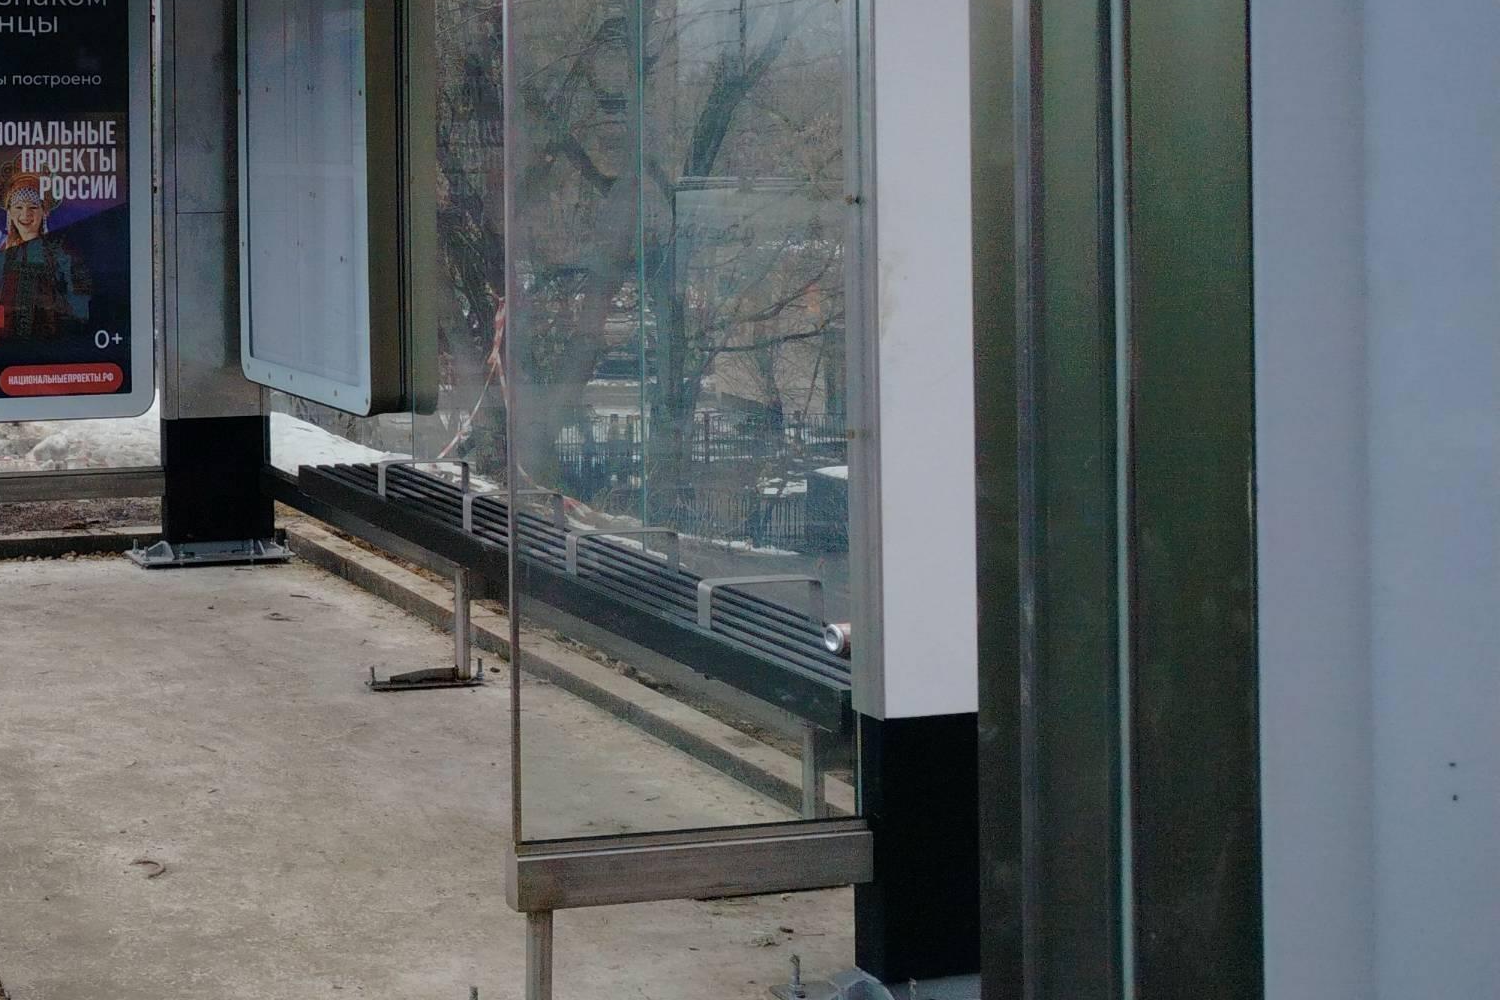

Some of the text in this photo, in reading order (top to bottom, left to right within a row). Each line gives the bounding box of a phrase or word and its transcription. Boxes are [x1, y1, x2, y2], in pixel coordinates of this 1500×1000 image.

[12, 74, 102, 88] построено
[21, 148, 117, 173] ПРОЕКТЫ
[40, 175, 117, 200] РОССИИ
[94, 330, 123, 349] 0+
[8, 371, 114, 386] НАЦИОНАЛЬНЫЕПРОЕКТЫ.РФ
